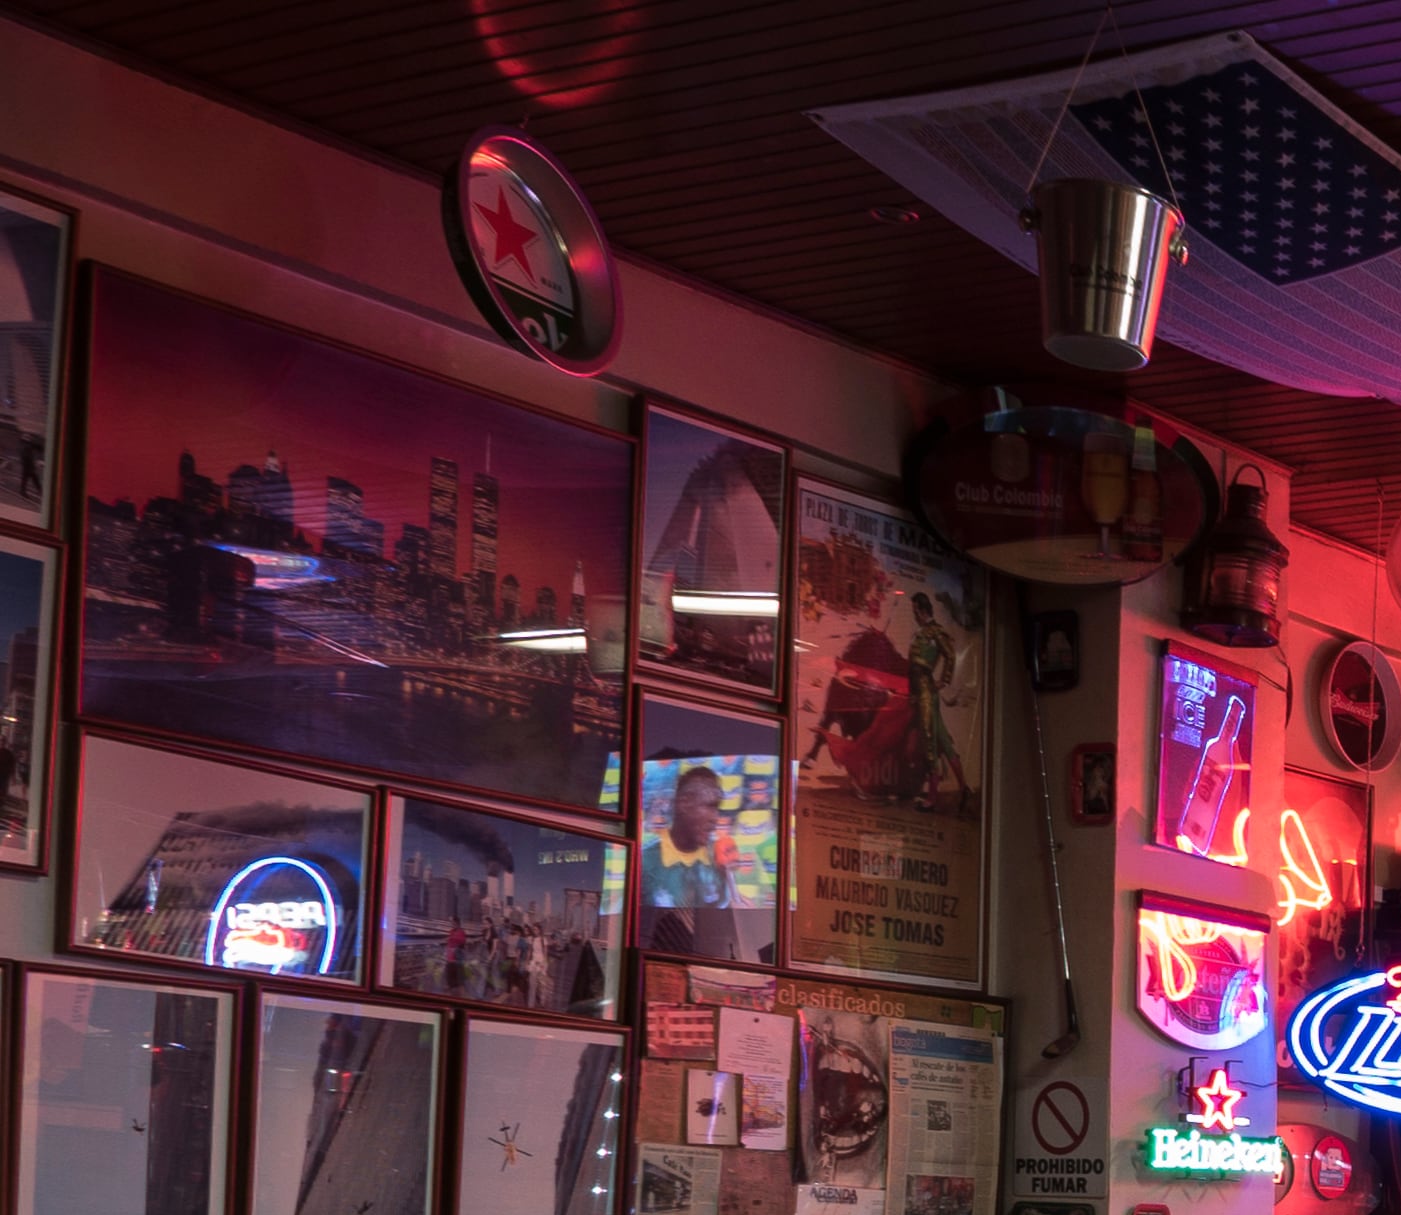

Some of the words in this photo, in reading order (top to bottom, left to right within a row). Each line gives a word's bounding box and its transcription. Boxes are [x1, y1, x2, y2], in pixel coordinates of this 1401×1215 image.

[955, 481, 990, 502] Club
[992, 486, 1065, 508] Colombia
[830, 845, 880, 876] CURRO
[884, 852, 948, 887] ROMERO
[816, 875, 888, 908] MAURICIO
[896, 887, 959, 919] VASQUEZ
[830, 909, 875, 938] JOSE
[882, 916, 945, 947] TOMAS
[778, 984, 906, 1018] clasificados
[1015, 1158, 1105, 1175] PROHIBIDO
[1152, 1128, 1283, 1173] Heineken
[1031, 1176, 1088, 1194] FUMAR
